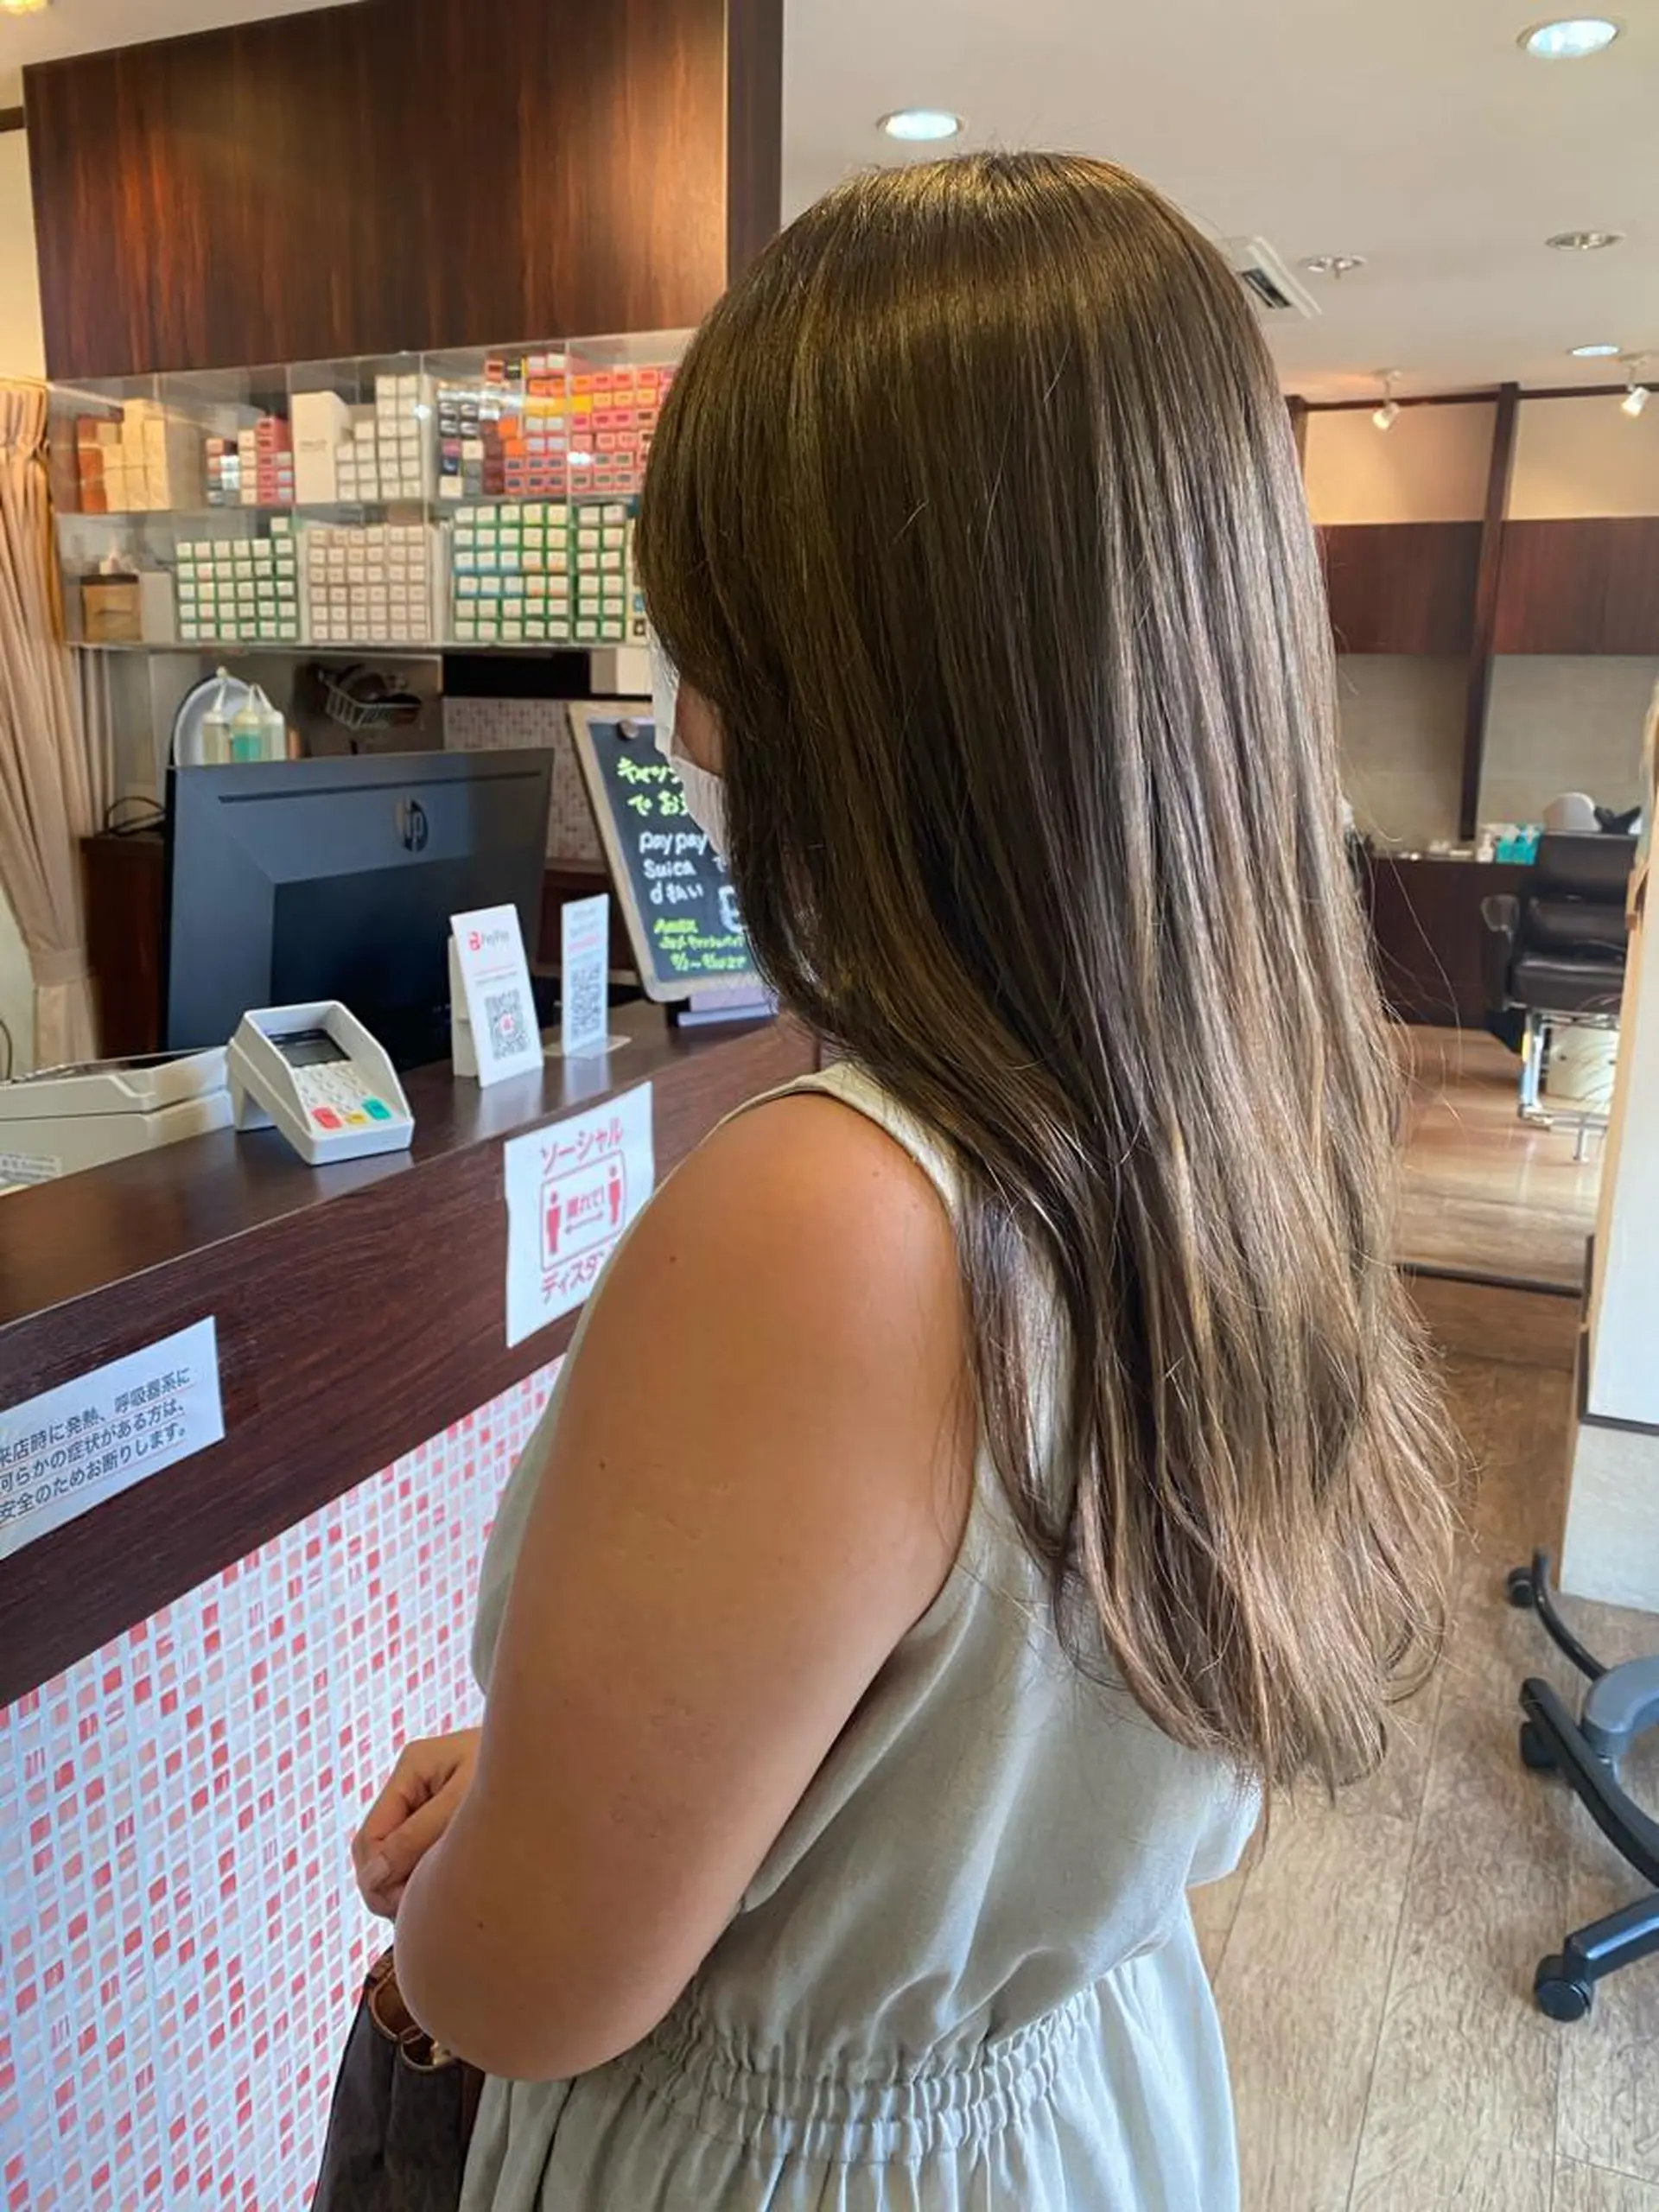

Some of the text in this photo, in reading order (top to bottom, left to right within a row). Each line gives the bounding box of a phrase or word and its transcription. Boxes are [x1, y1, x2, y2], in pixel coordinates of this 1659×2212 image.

[643, 858, 696, 880] Suica
[540, 1116, 624, 1176] ソーシャル
[541, 1250, 604, 1306] ディスタ
